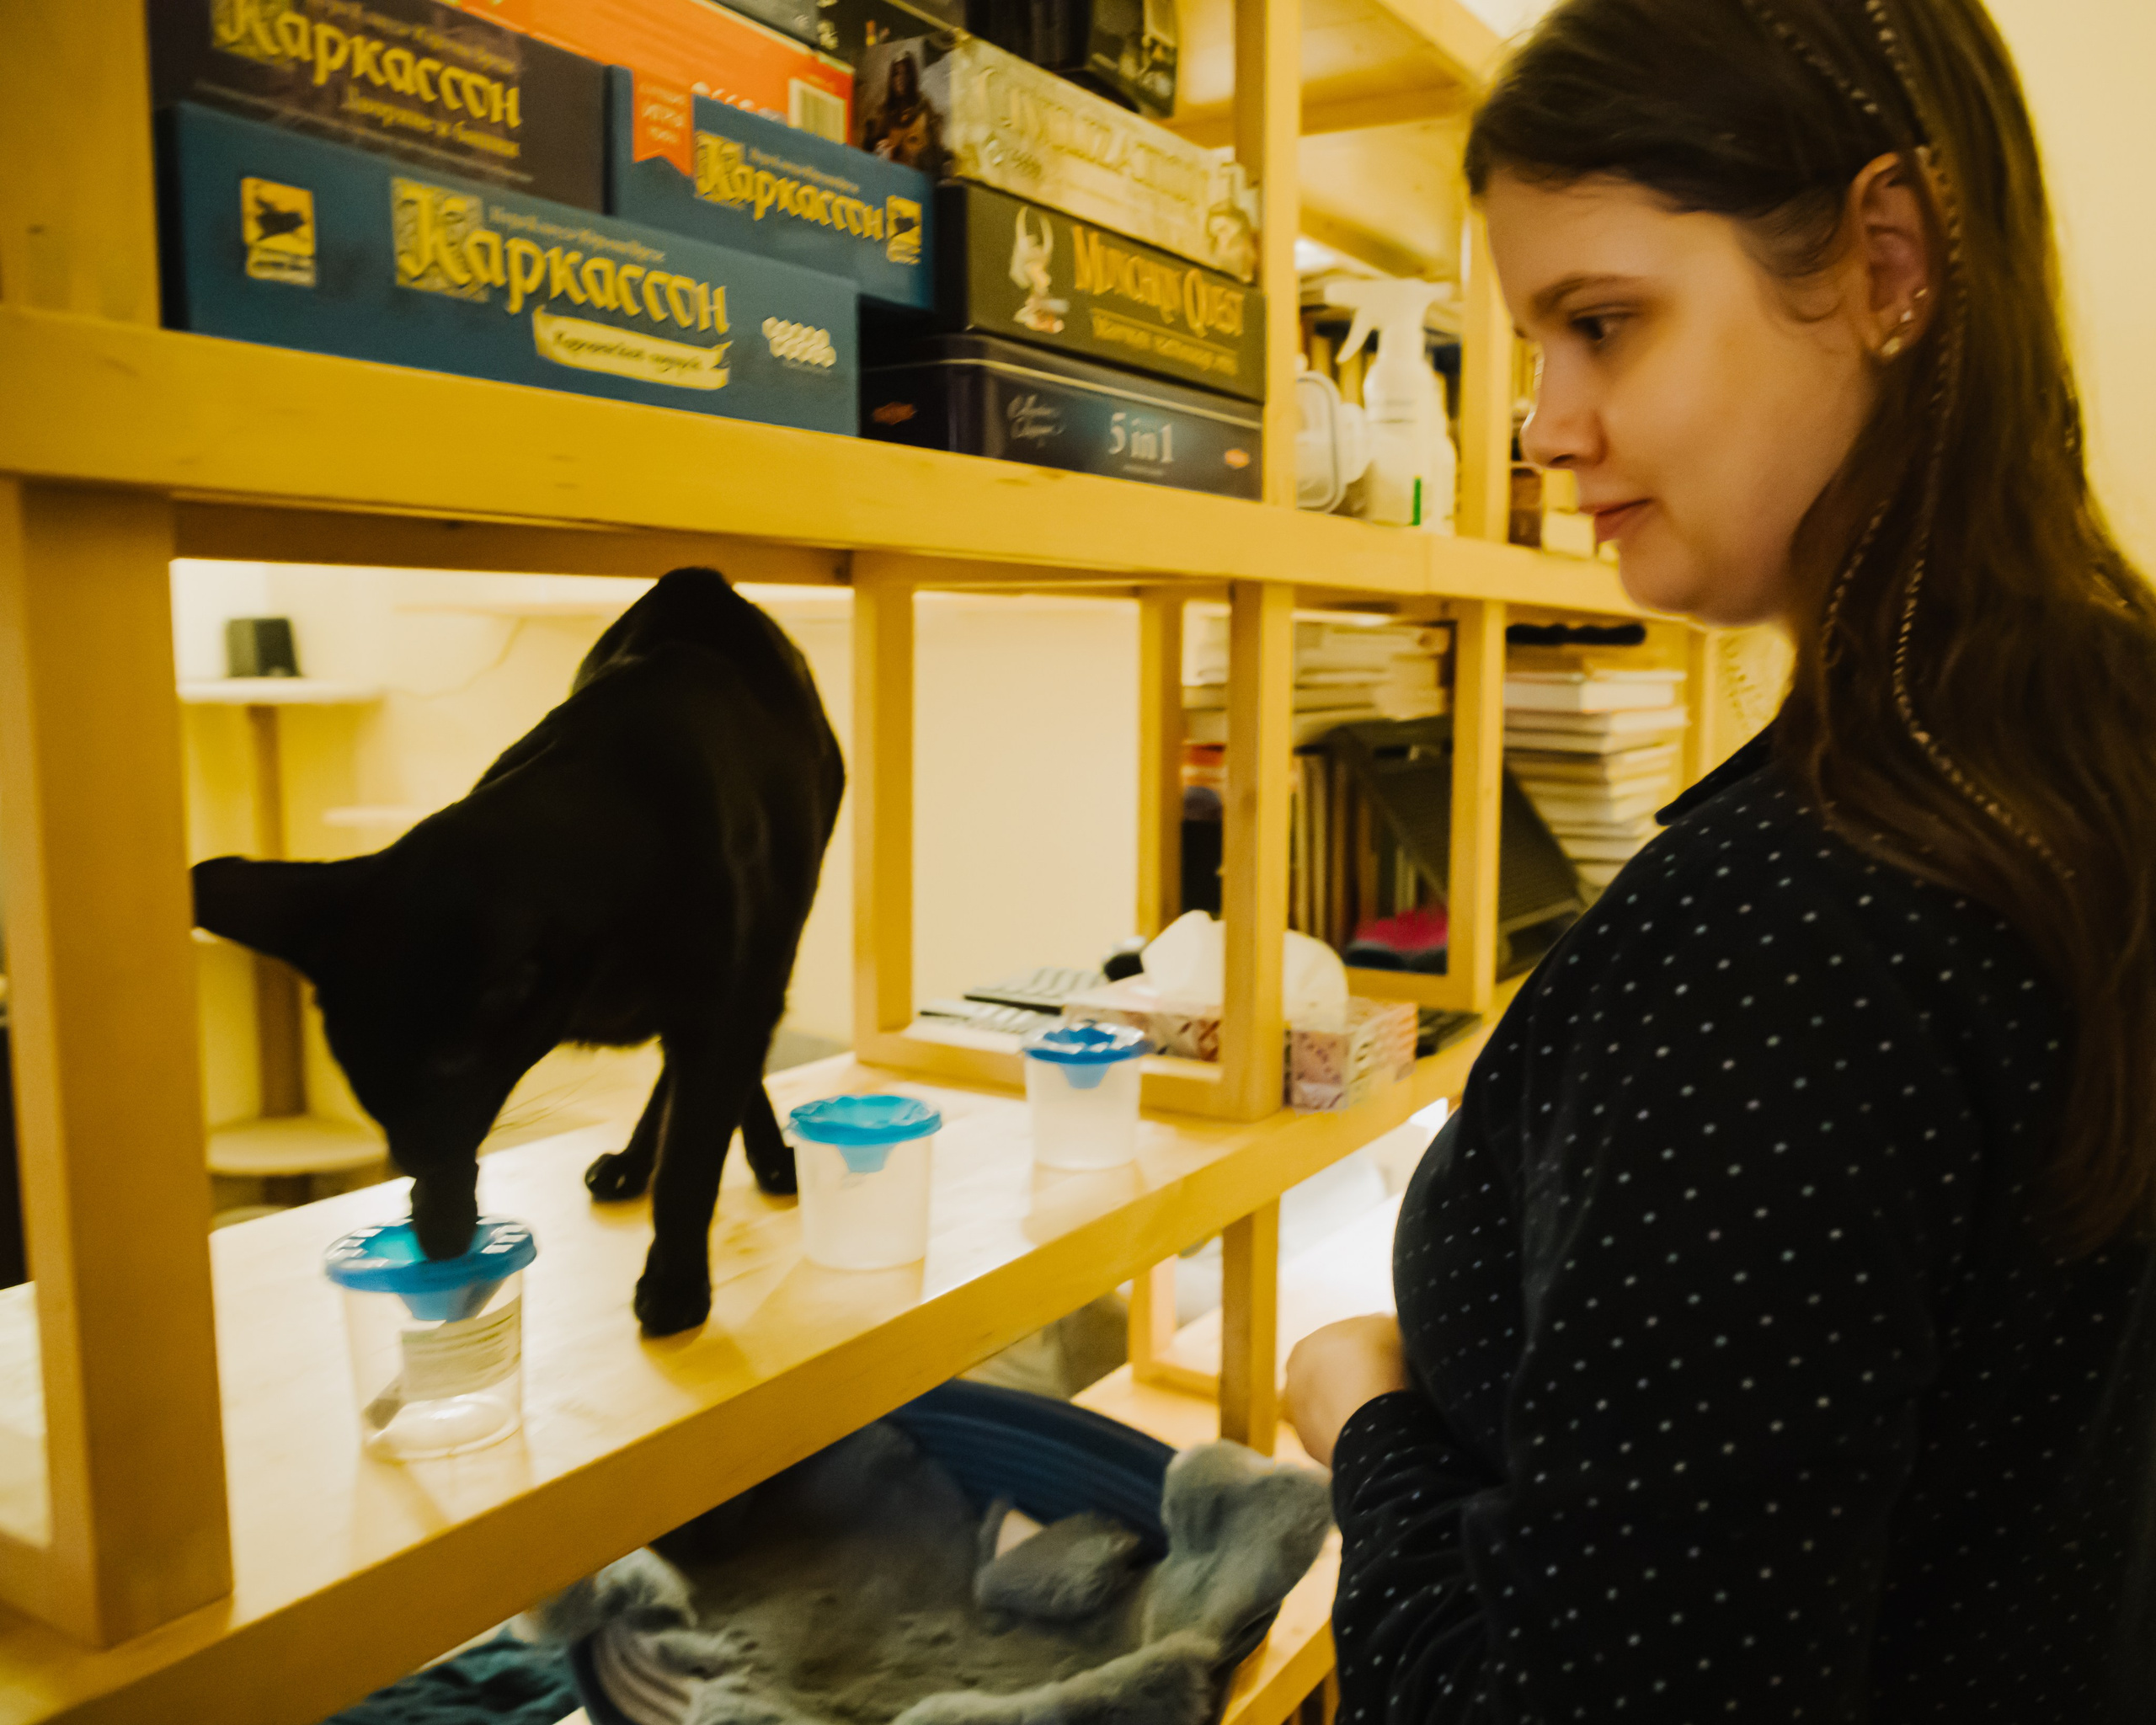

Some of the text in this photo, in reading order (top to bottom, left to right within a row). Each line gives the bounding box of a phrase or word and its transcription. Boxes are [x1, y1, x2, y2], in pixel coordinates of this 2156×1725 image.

[216, 0, 521, 129] Каркассон
[695, 131, 884, 241] Каркассон
[398, 181, 731, 334] Каркассон
[1107, 411, 1128, 456] 5
[1129, 417, 1160, 462] in
[1160, 422, 1175, 464] 1
